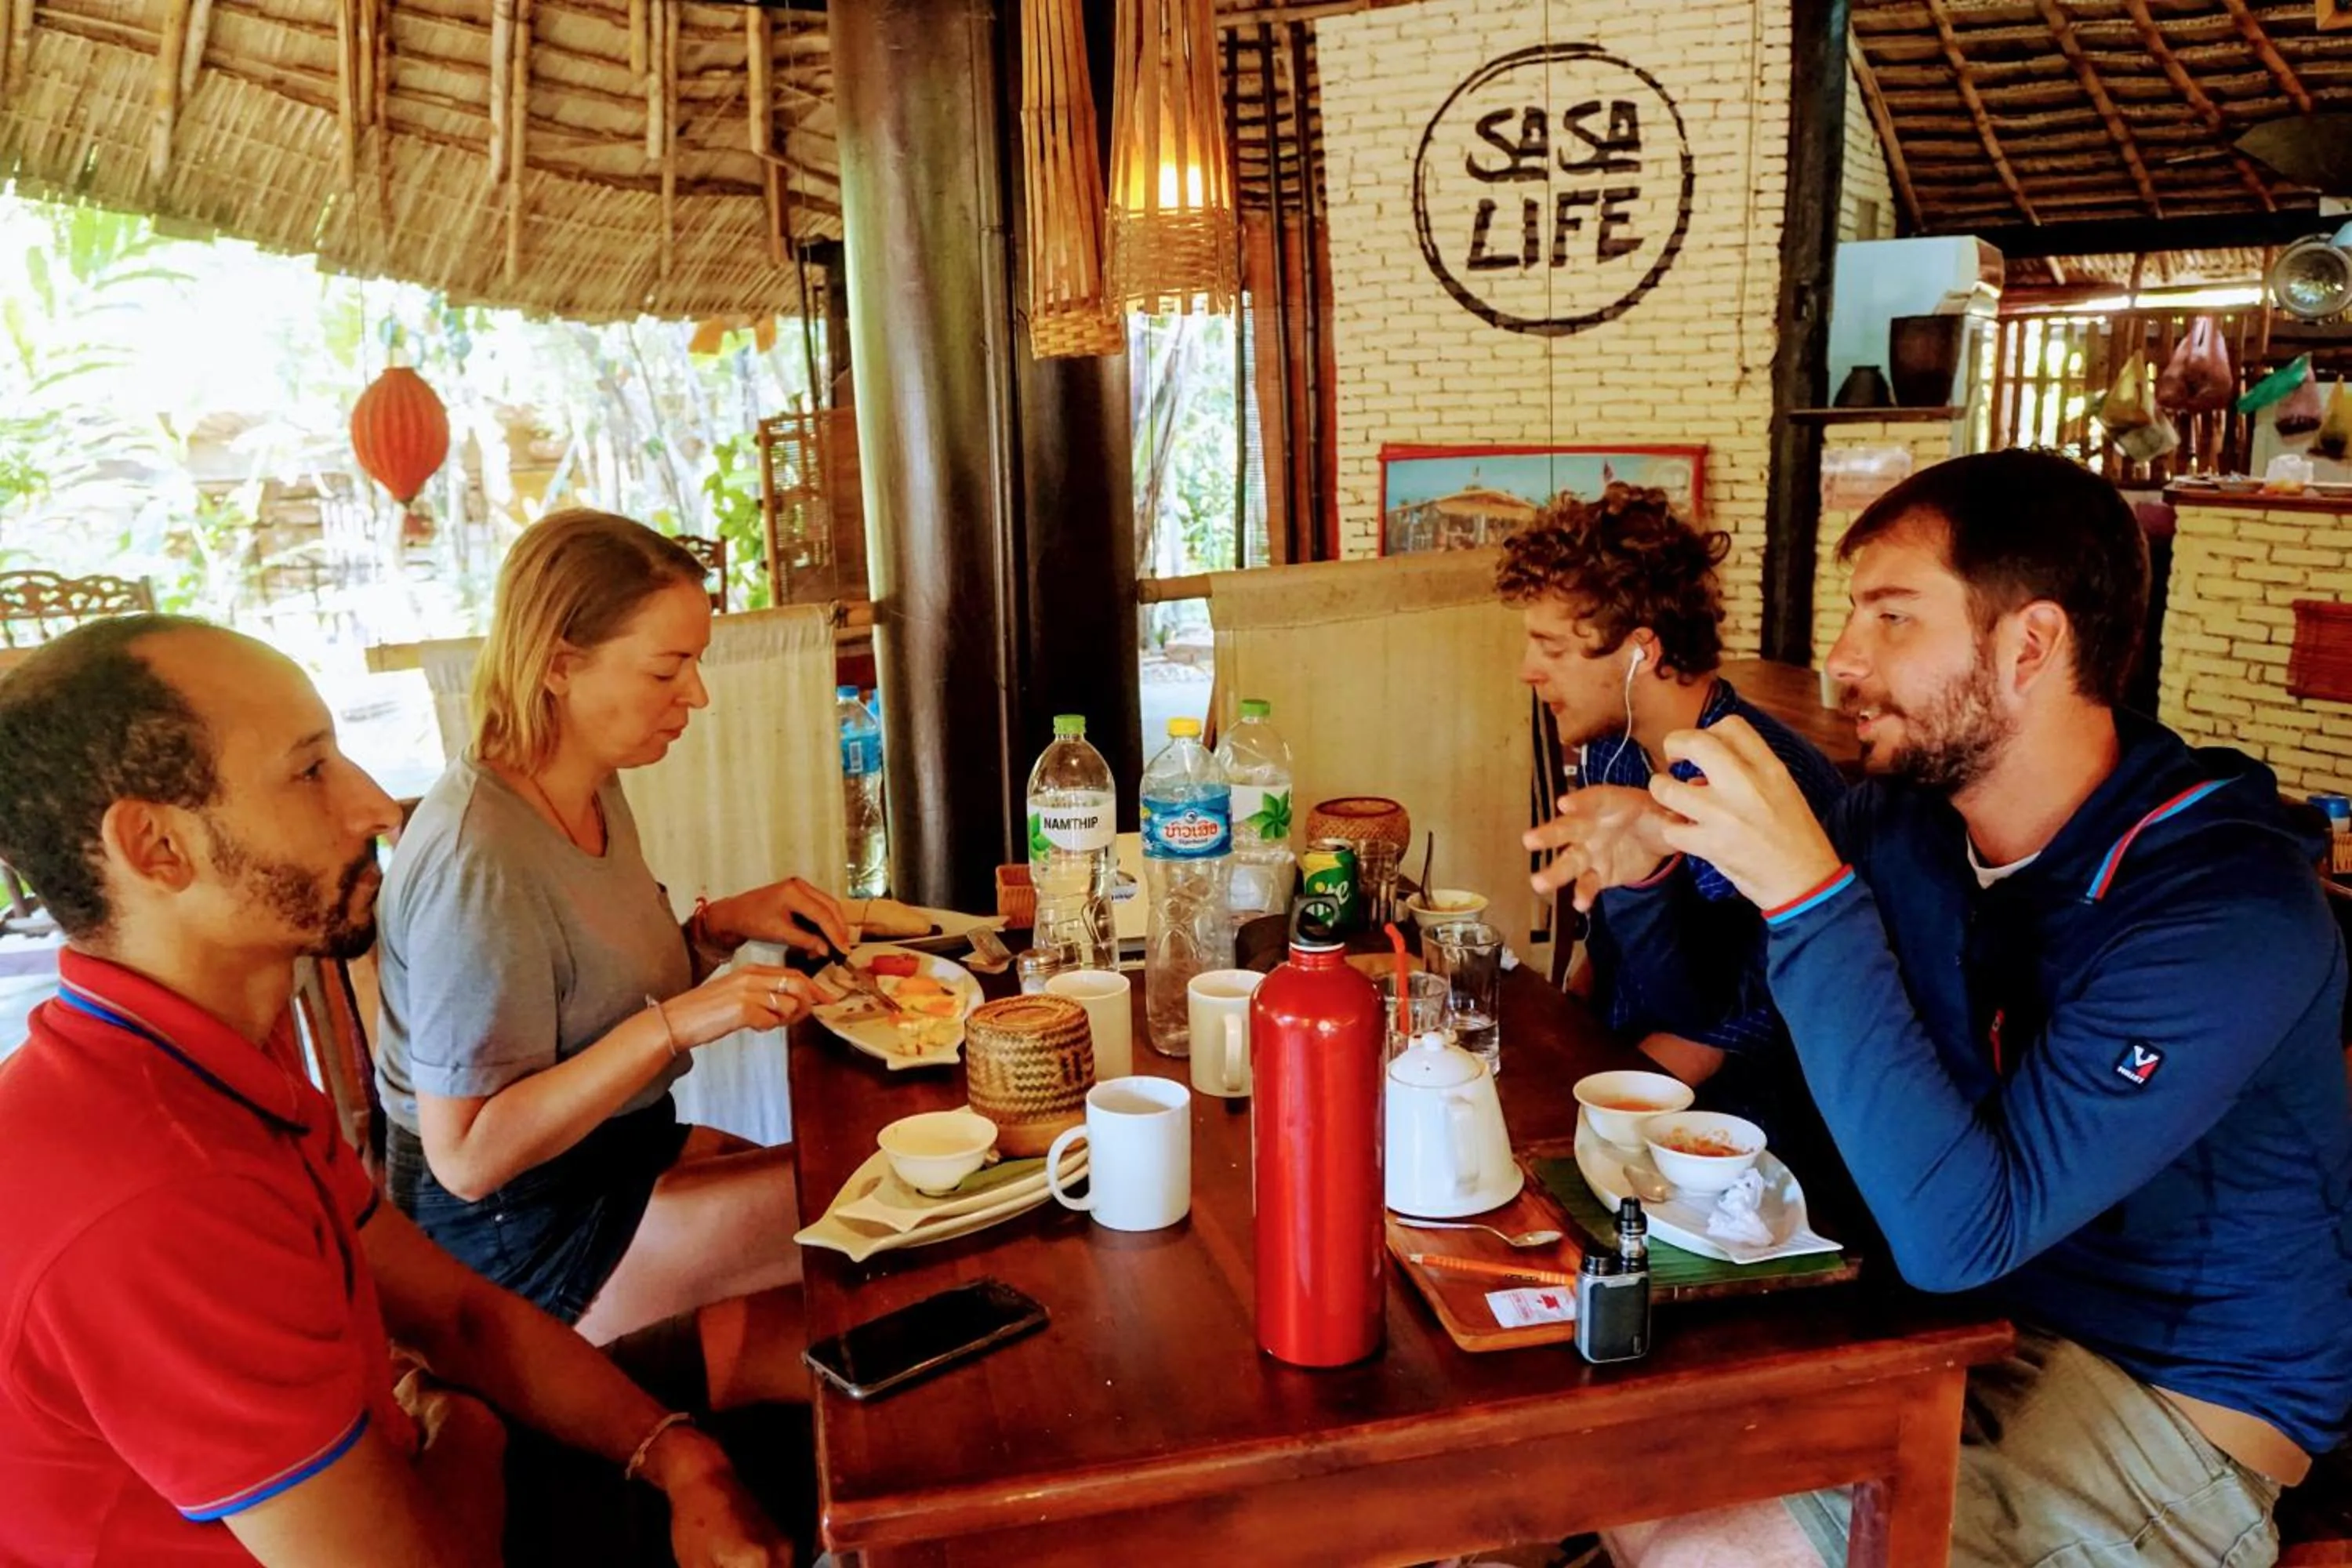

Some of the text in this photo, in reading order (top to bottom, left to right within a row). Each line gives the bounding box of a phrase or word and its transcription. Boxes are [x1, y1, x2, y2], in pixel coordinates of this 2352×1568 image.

[1466, 100, 1642, 183] SASA
[1467, 187, 1645, 270] LIFE
[1044, 816, 1098, 830] NAMTHIP
